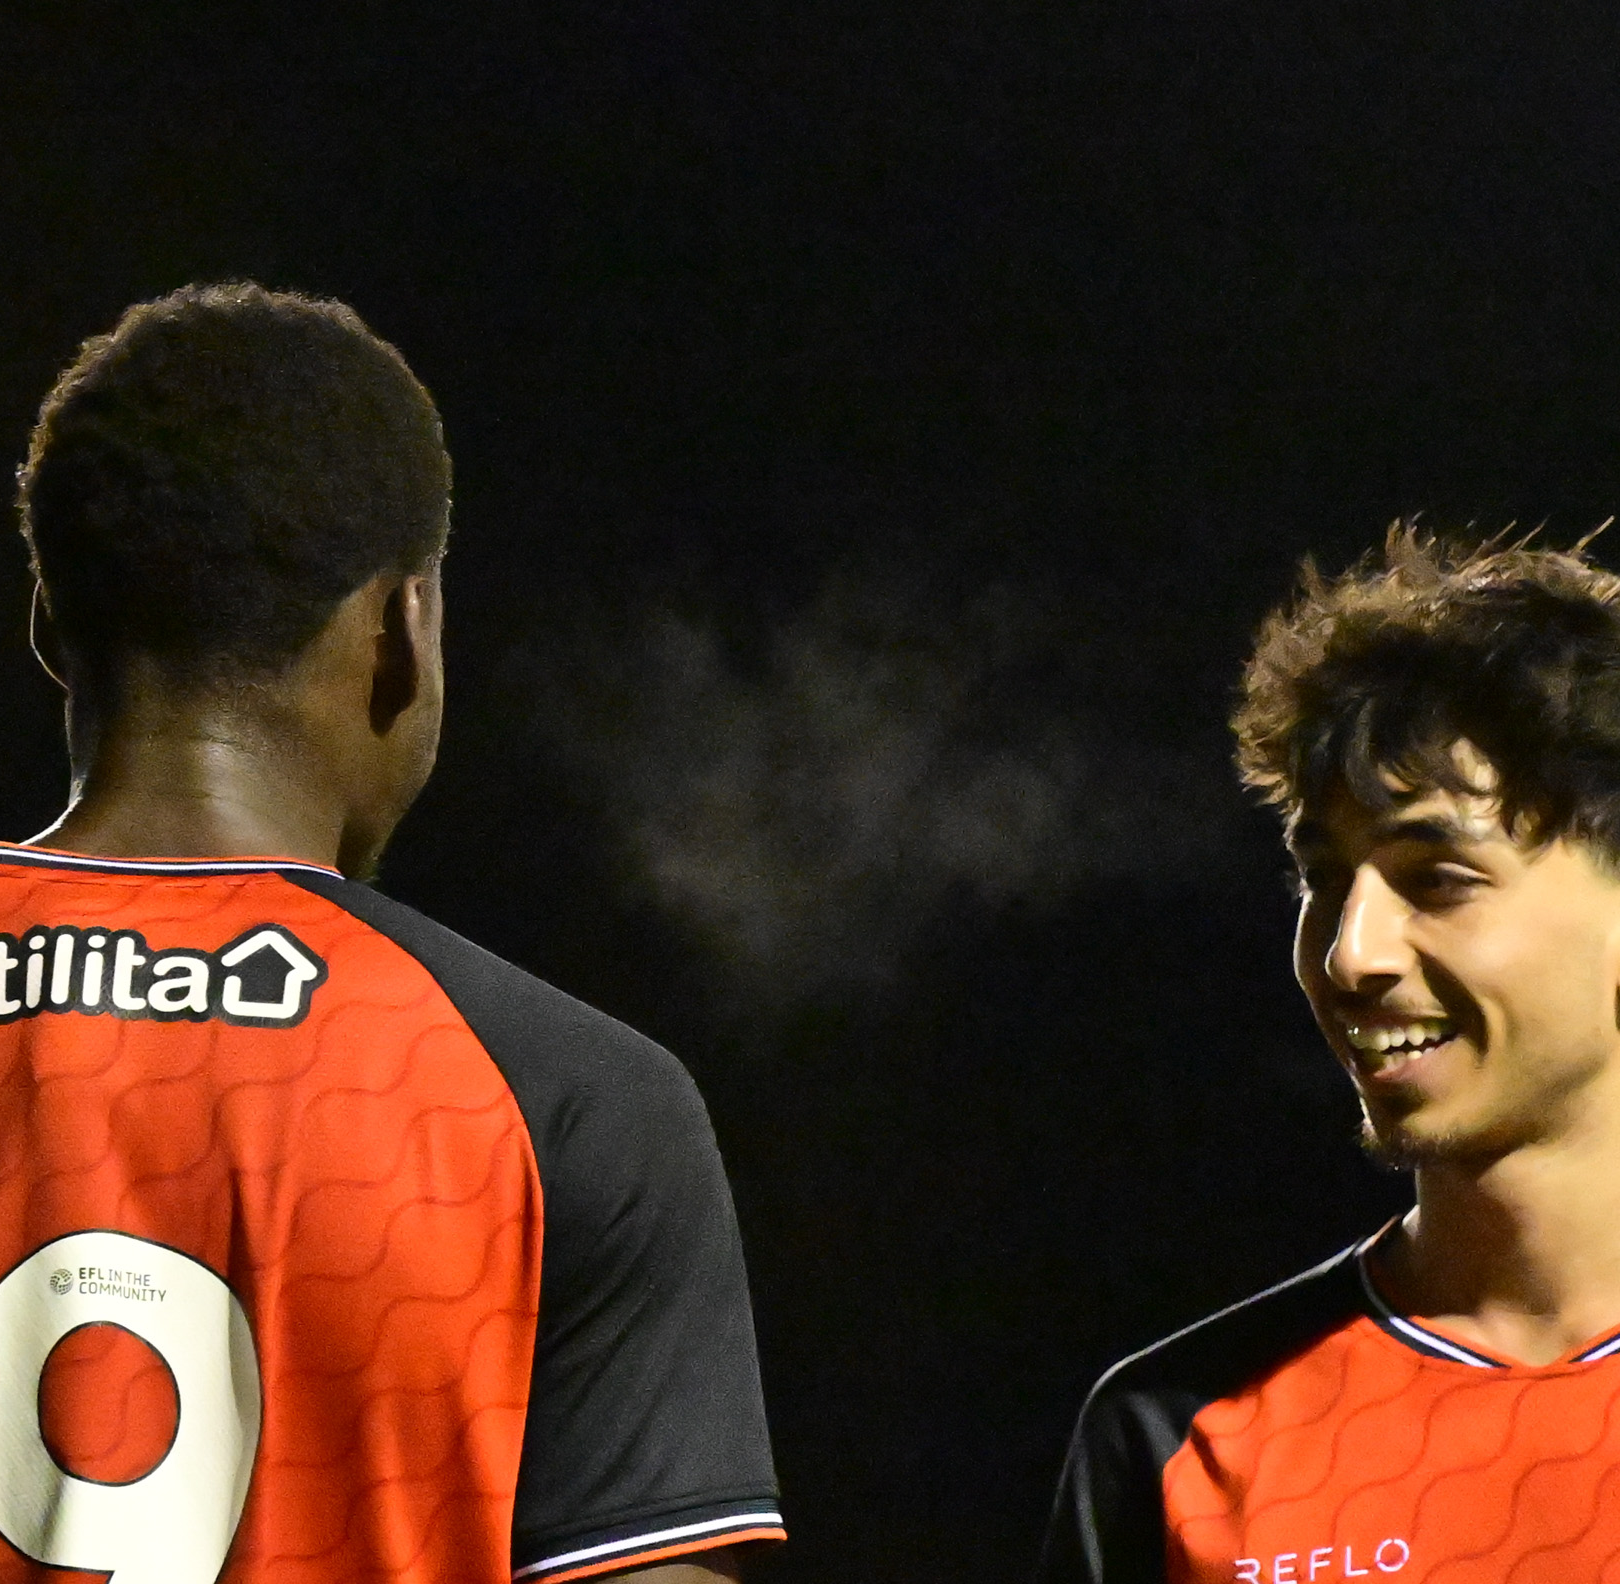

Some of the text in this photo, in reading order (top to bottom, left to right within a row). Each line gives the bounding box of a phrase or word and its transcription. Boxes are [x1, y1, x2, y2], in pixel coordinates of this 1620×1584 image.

[79, 1267, 151, 1287] EFL IN THE
[79, 1281, 167, 1302] COMMUNITY
